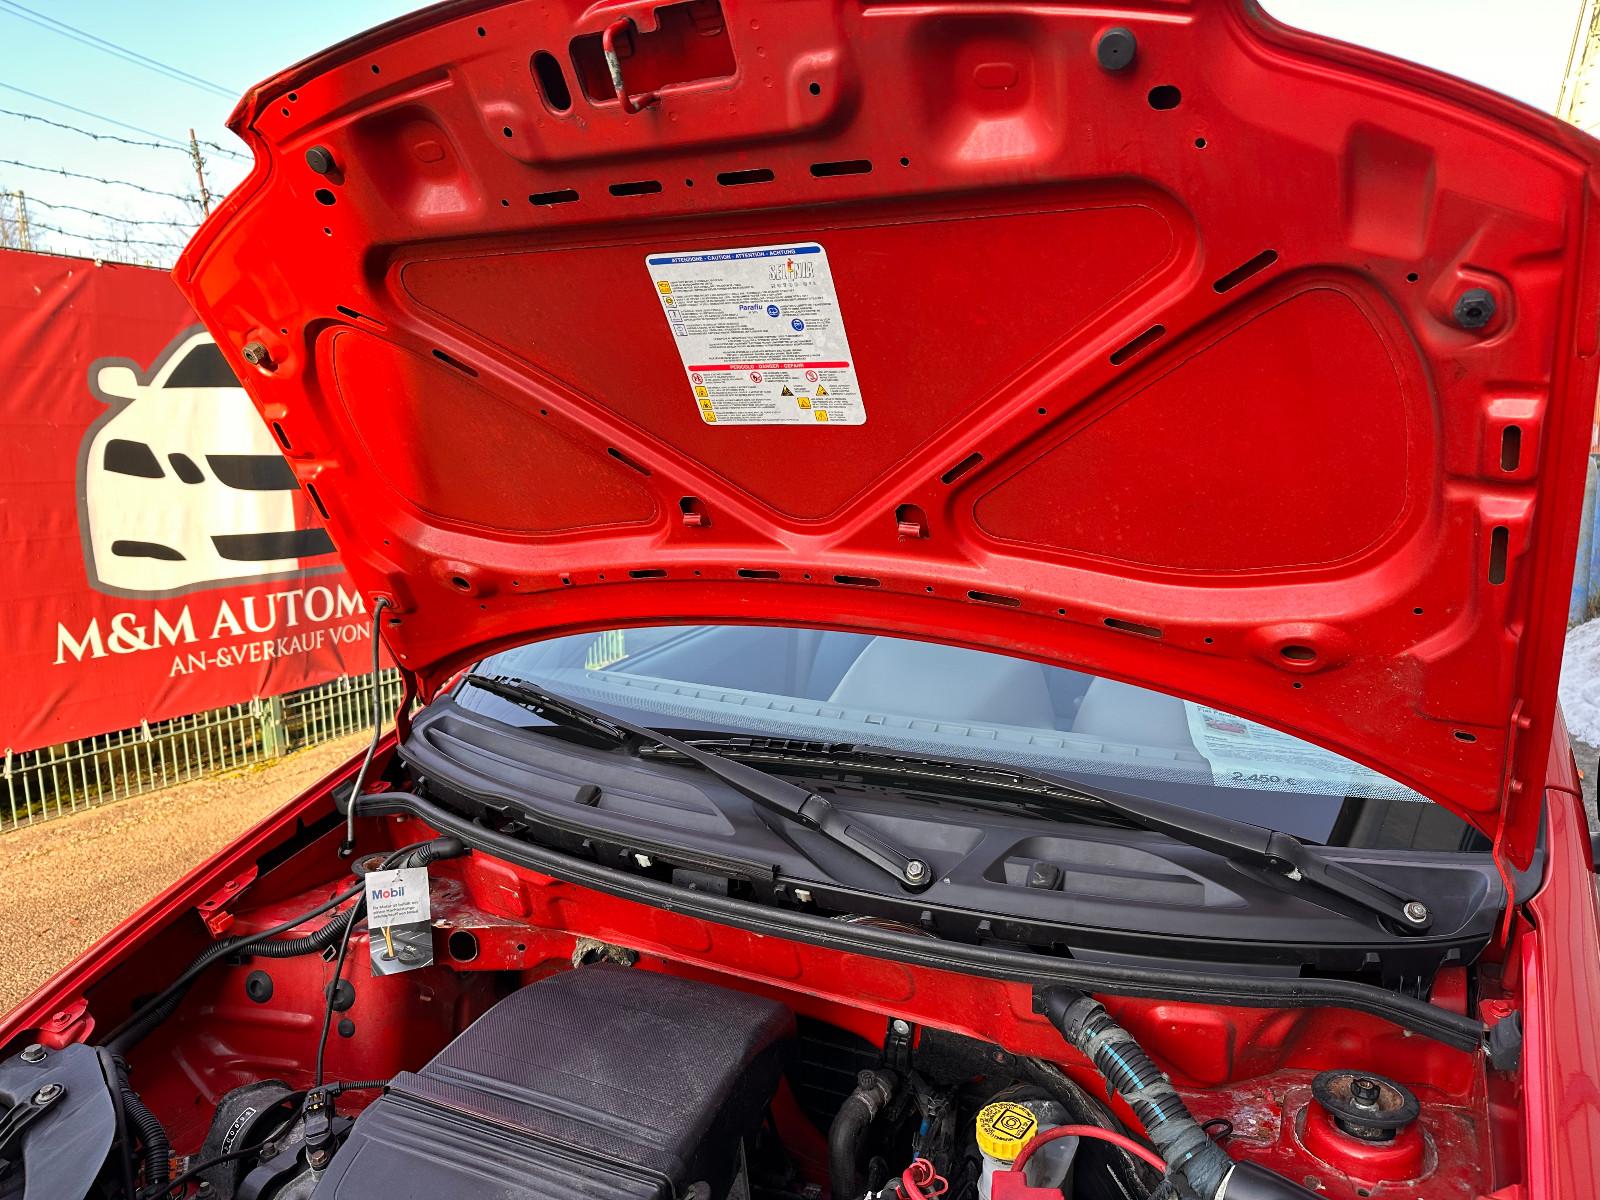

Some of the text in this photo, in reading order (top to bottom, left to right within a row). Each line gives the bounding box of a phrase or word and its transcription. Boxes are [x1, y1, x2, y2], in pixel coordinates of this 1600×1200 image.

[53, 584, 367, 665] M&M AUTOM
[169, 622, 370, 677] AN-&VERKAUF VON
[1230, 771, 1281, 784] 2.450
[372, 887, 405, 899] Mobil
